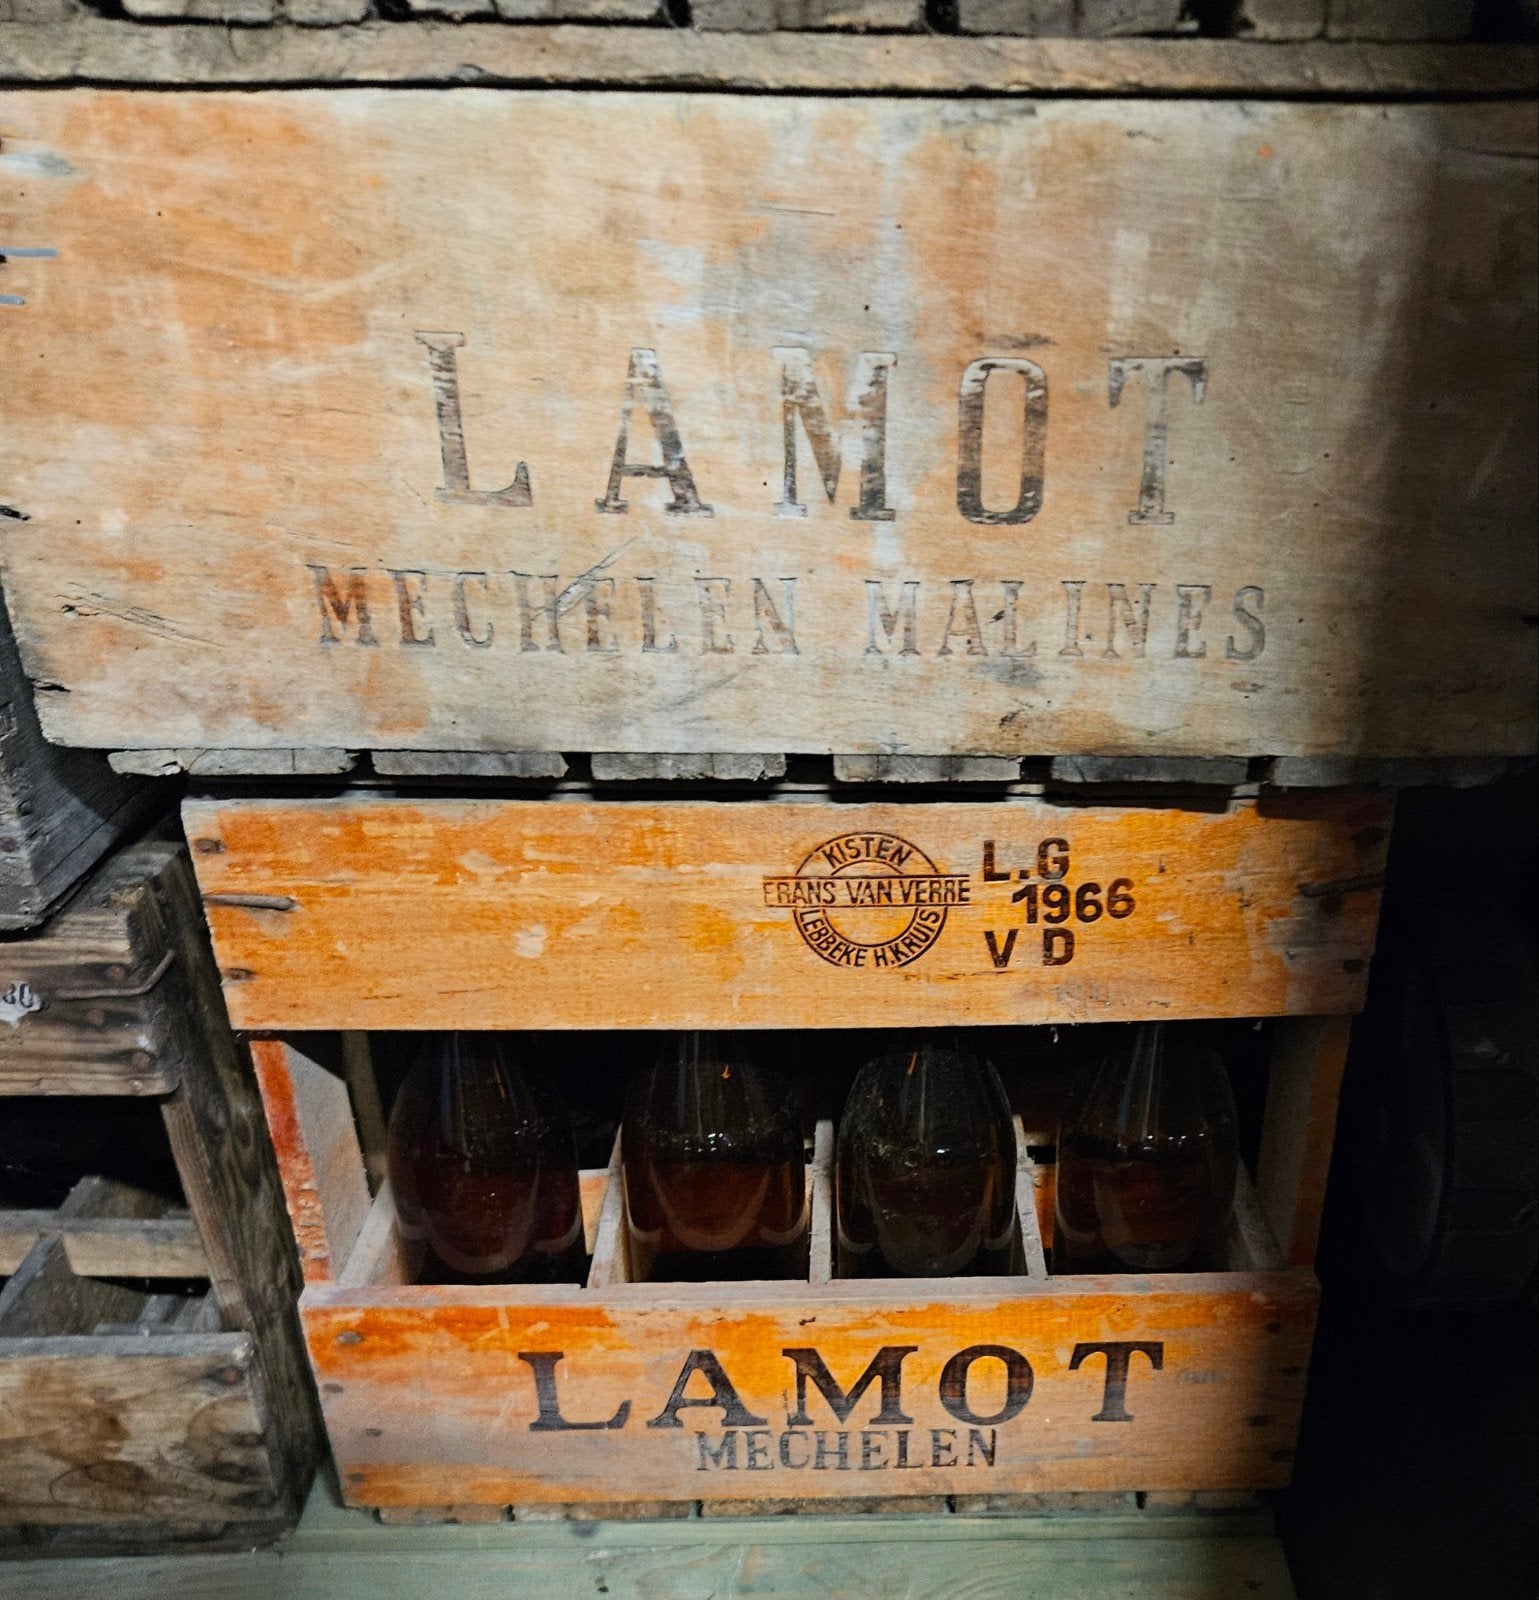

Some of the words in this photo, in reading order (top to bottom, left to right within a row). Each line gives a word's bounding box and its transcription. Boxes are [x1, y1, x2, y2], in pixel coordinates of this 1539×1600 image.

[414, 331, 1207, 525] LAMOT
[307, 564, 799, 655] MECHELEN
[864, 579, 1266, 661] MALINES
[821, 836, 913, 869] KISTEN
[763, 879, 836, 906] FRANS
[846, 879, 899, 907] VAN
[902, 877, 970, 904] VERRE
[1011, 878, 1136, 925] 1966
[800, 909, 867, 968] LEBBEKE
[874, 908, 941, 968] H.KRUIS
[984, 929, 1018, 968] V
[1042, 928, 1076, 967] D
[518, 1341, 1165, 1431] LAMOT
[694, 1429, 997, 1471] MECHELEN
